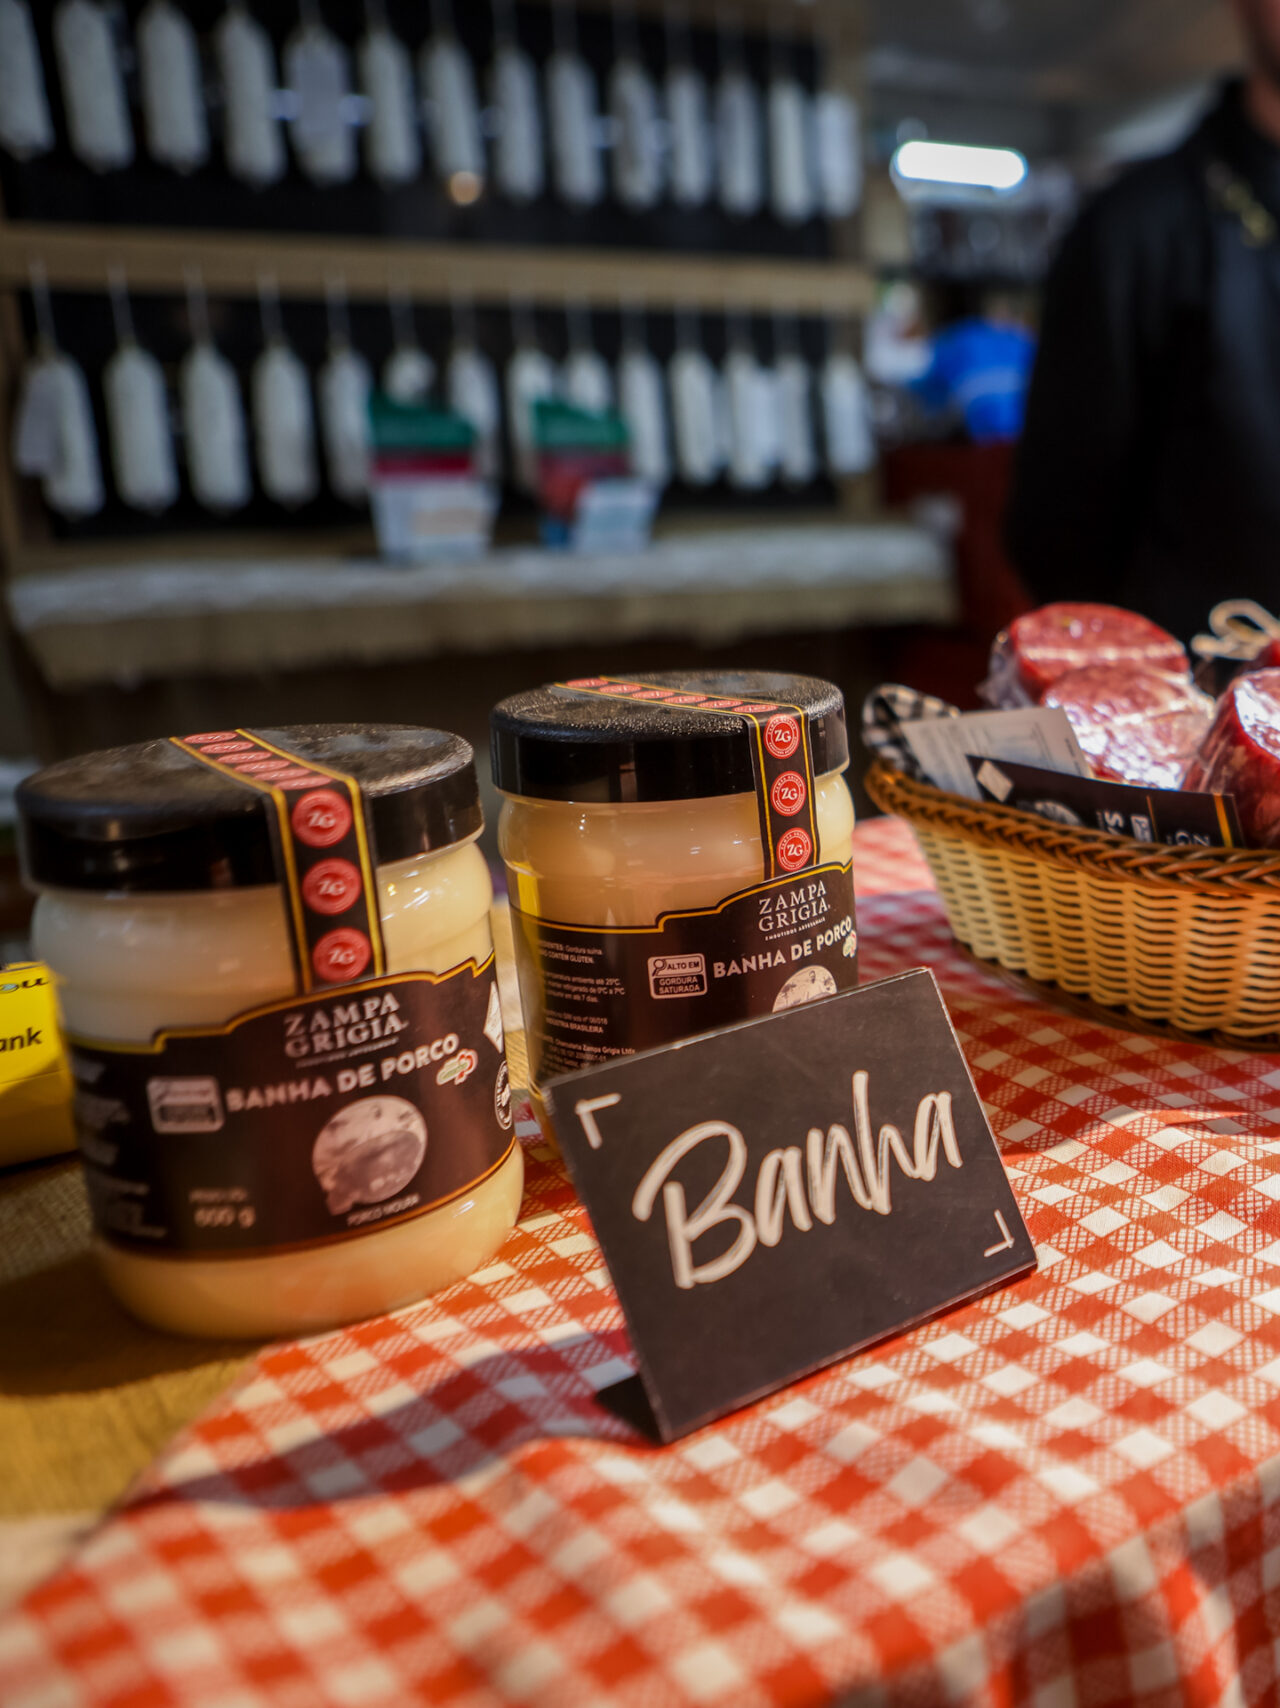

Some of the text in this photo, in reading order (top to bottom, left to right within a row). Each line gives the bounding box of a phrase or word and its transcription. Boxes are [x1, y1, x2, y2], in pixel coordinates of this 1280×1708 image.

[774, 730, 791, 743] ZG
[781, 787, 798, 800] ZG
[307, 810, 336, 828] ZG
[787, 844, 803, 856] ZG
[317, 878, 346, 896] ZG
[759, 880, 826, 915] ZAMPA
[758, 897, 827, 932] GRIGIA
[328, 947, 356, 965] ZG
[713, 915, 852, 979] BANHA DE PORCO
[667, 962, 687, 970] ALTO
[659, 976, 698, 986] GORDURA
[659, 984, 700, 994] SATURADA
[284, 992, 400, 1036] ZAMPA
[226, 1077, 332, 1112] BANHA
[337, 1063, 376, 1093] DE
[381, 1033, 459, 1081] PORCO
[632, 1069, 963, 1289] Banha
